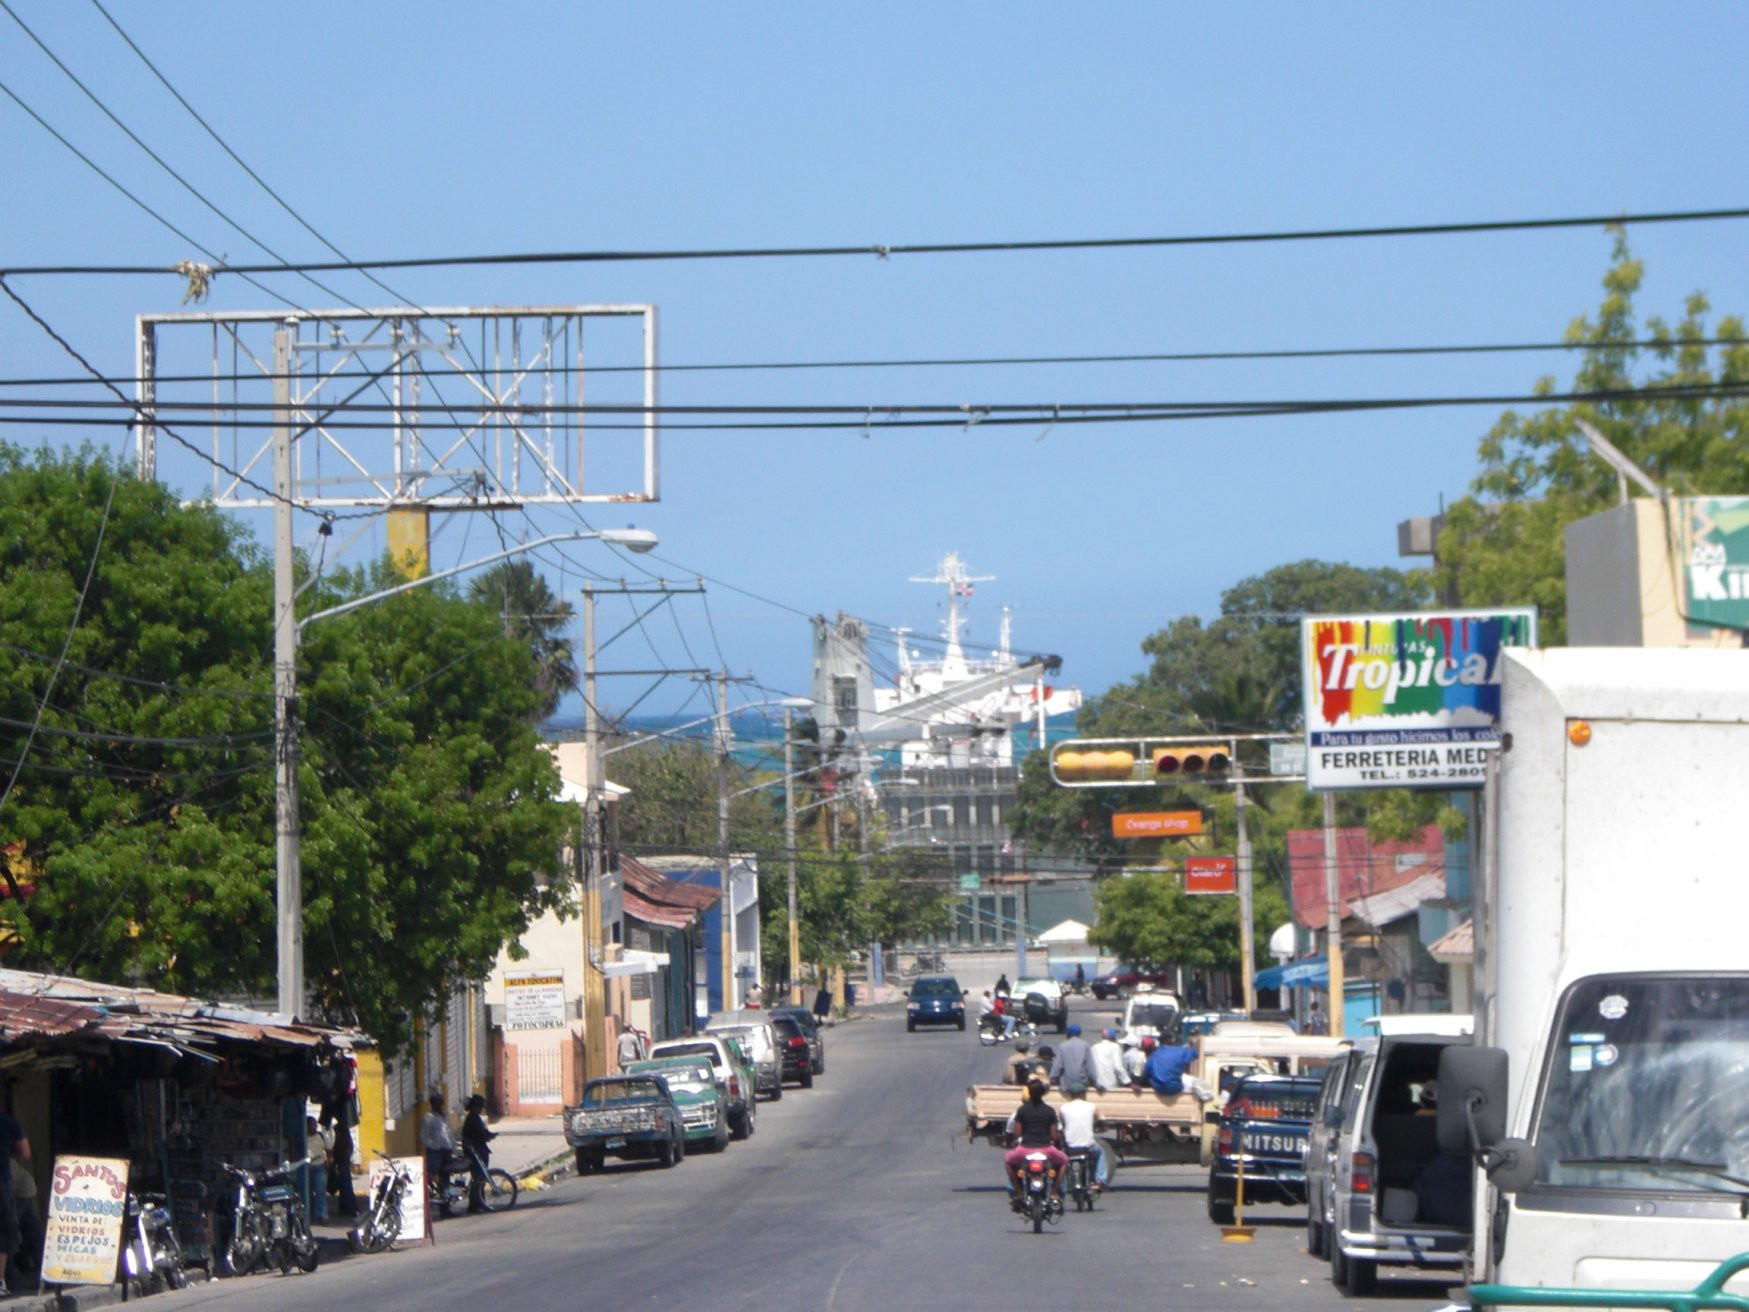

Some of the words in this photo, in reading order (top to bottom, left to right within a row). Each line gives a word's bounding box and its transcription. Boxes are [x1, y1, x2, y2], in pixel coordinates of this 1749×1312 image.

[1357, 639, 1426, 656] PINTUAS
[1323, 639, 1504, 704] Tropical
[1321, 733, 1349, 745] Para
[1350, 733, 1362, 744] tu
[1364, 732, 1398, 745] gusto
[1399, 731, 1449, 743] hicimos
[1451, 729, 1470, 741] los
[1321, 749, 1440, 769] FERRETERIA
[1446, 748, 1488, 765] MED
[1126, 819, 1162, 833] Orange
[1164, 818, 1189, 829] shop
[1190, 864, 1224, 878] Claro
[54, 1164, 127, 1199] SANTOS
[54, 1196, 125, 1217] VIDRIOS
[58, 1215, 89, 1224] VENTA
[58, 1225, 105, 1236] VIDRIOS
[56, 1253, 62, 1261] Y
[57, 1244, 97, 1255] MICAS
[62, 1268, 81, 1276] AQUI
